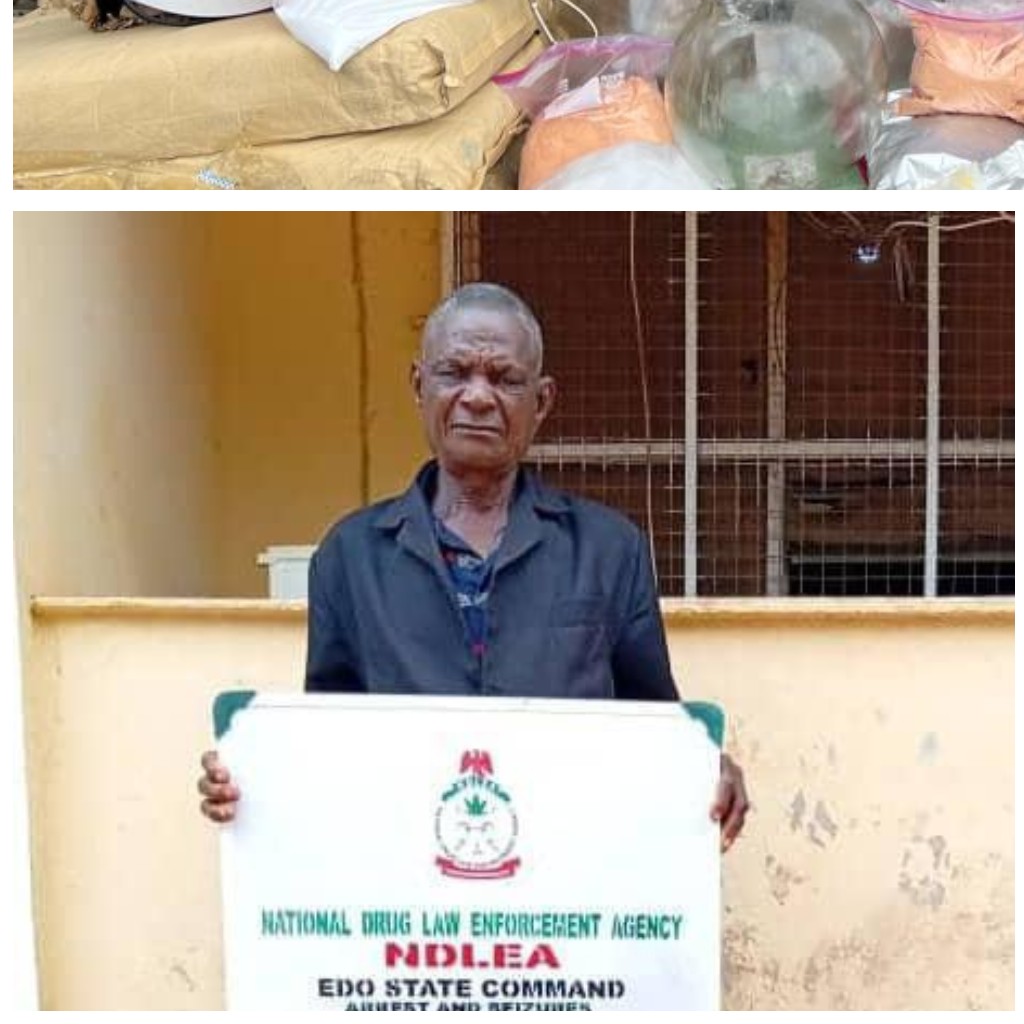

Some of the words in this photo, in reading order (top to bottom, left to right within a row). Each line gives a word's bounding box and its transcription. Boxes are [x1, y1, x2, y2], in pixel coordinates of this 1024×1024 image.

[261, 908, 352, 936] NATIONAL
[361, 910, 411, 937] DRUG
[422, 911, 460, 937] LAW
[470, 911, 602, 938] ENFORCEMENT
[611, 913, 684, 940] AGENCY
[385, 942, 561, 969] NDLEA
[318, 978, 375, 997] EDO
[385, 978, 472, 997] STATE
[481, 979, 626, 999] COMMAND
